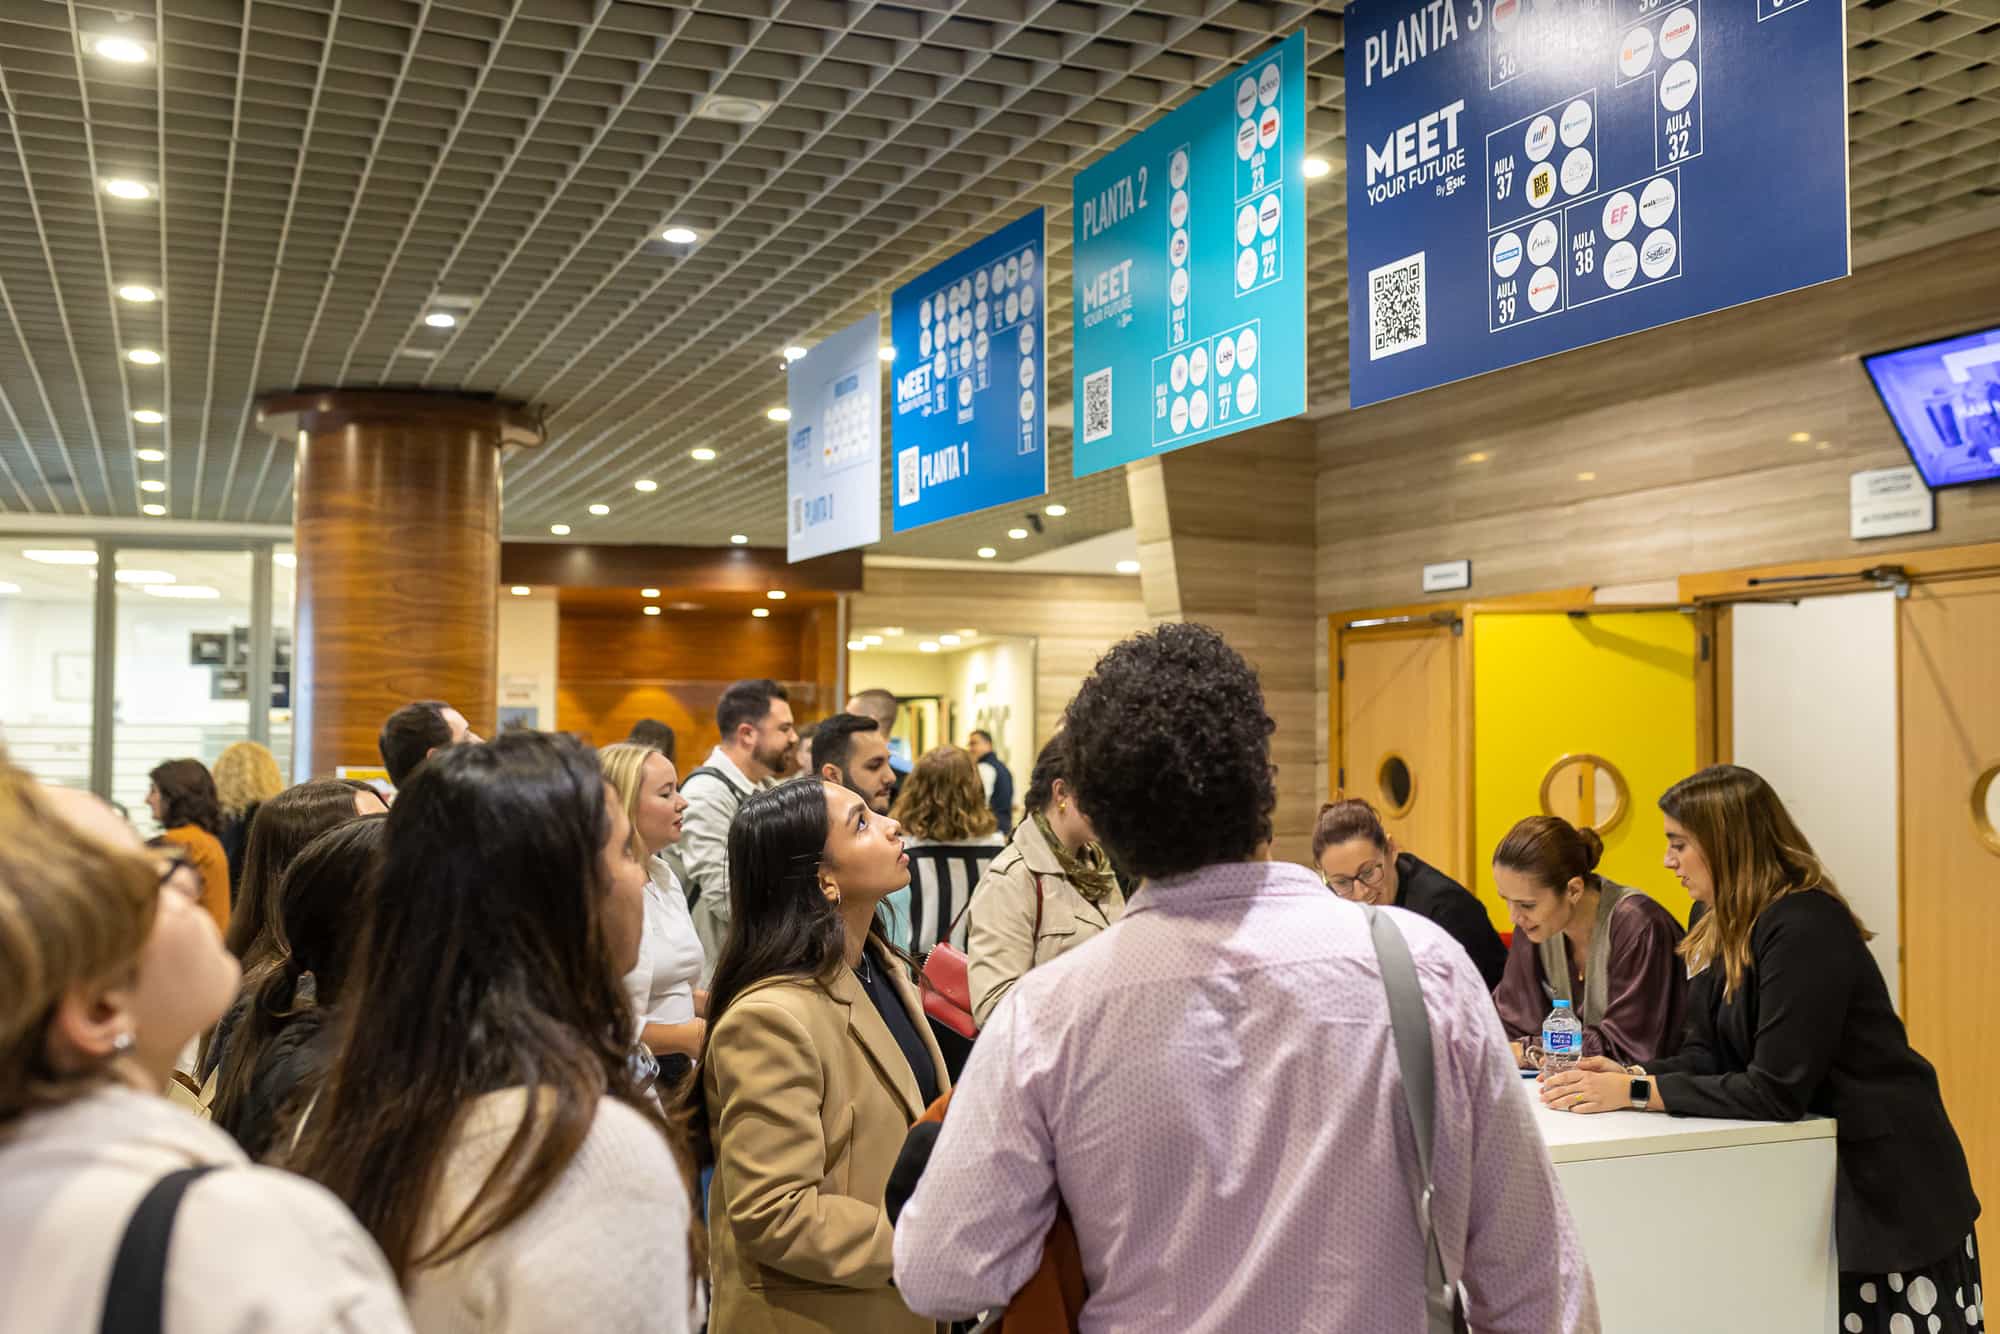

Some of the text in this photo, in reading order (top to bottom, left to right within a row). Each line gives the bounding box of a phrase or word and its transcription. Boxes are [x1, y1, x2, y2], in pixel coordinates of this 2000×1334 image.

[1365, 0, 1458, 88] PLANTA
[1665, 111, 1692, 136] AULA
[1366, 98, 1465, 187] MEET
[1668, 130, 1690, 162] 32
[1252, 165, 1265, 193] 23
[1367, 147, 1466, 207] YOUR FUTURE
[1494, 154, 1514, 177] AULA
[1497, 172, 1513, 201] 37
[1083, 166, 1148, 241] PLANTA 2
[1610, 205, 1629, 225] EF
[1572, 230, 1596, 252] AULA
[1263, 254, 1275, 279] 22
[1575, 247, 1594, 277] 38
[1083, 259, 1133, 315] MEET
[1497, 280, 1518, 300] AULA
[1499, 297, 1516, 324] 39
[898, 363, 932, 403] MEET
[1219, 397, 1230, 421] 27
[921, 441, 969, 488] PLANTA 1
